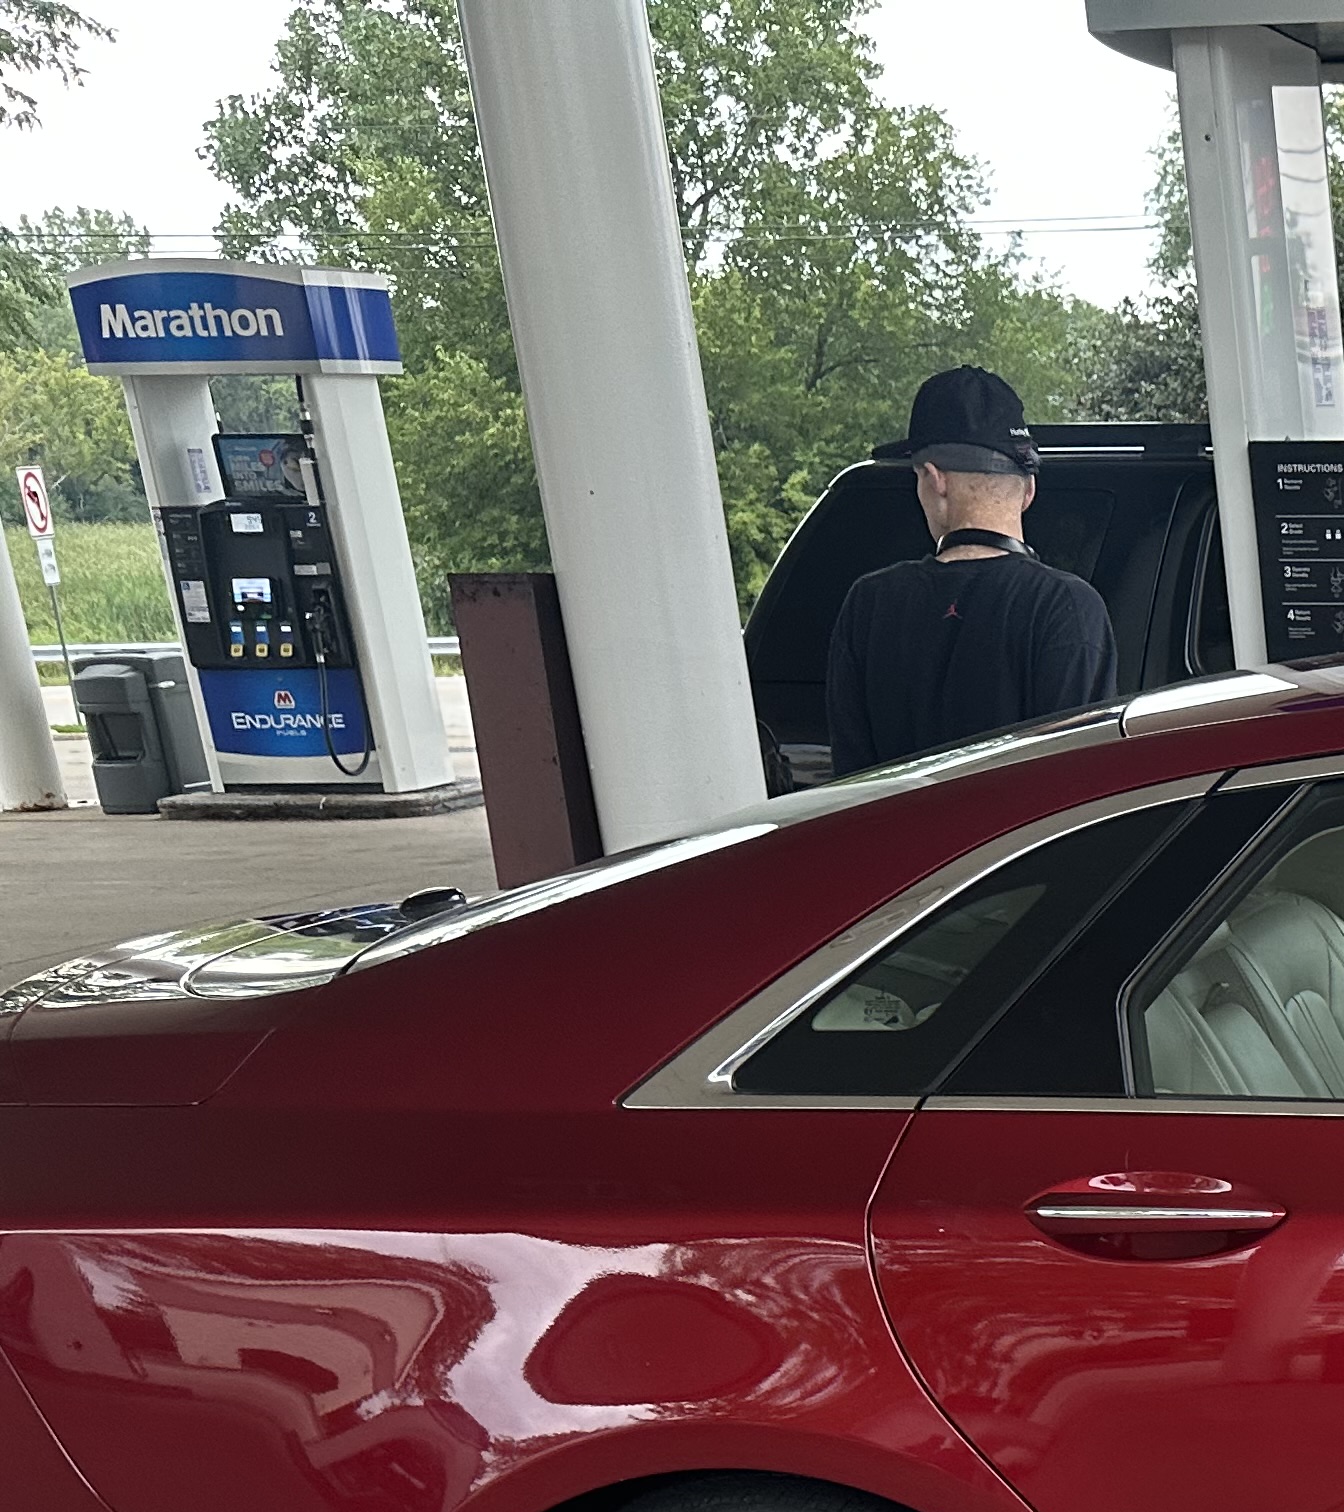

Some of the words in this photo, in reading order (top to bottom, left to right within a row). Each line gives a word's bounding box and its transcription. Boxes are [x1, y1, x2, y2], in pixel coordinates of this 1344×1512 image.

[100, 302, 284, 338] Marathon
[1277, 464, 1343, 473] INSTRUCTIONS
[1277, 478, 1283, 490] 1
[309, 512, 317, 523] 2
[1281, 522, 1289, 534] 2
[1283, 566, 1291, 578] 3
[1287, 609, 1295, 621] 4
[231, 712, 345, 729] ENDURANCE
